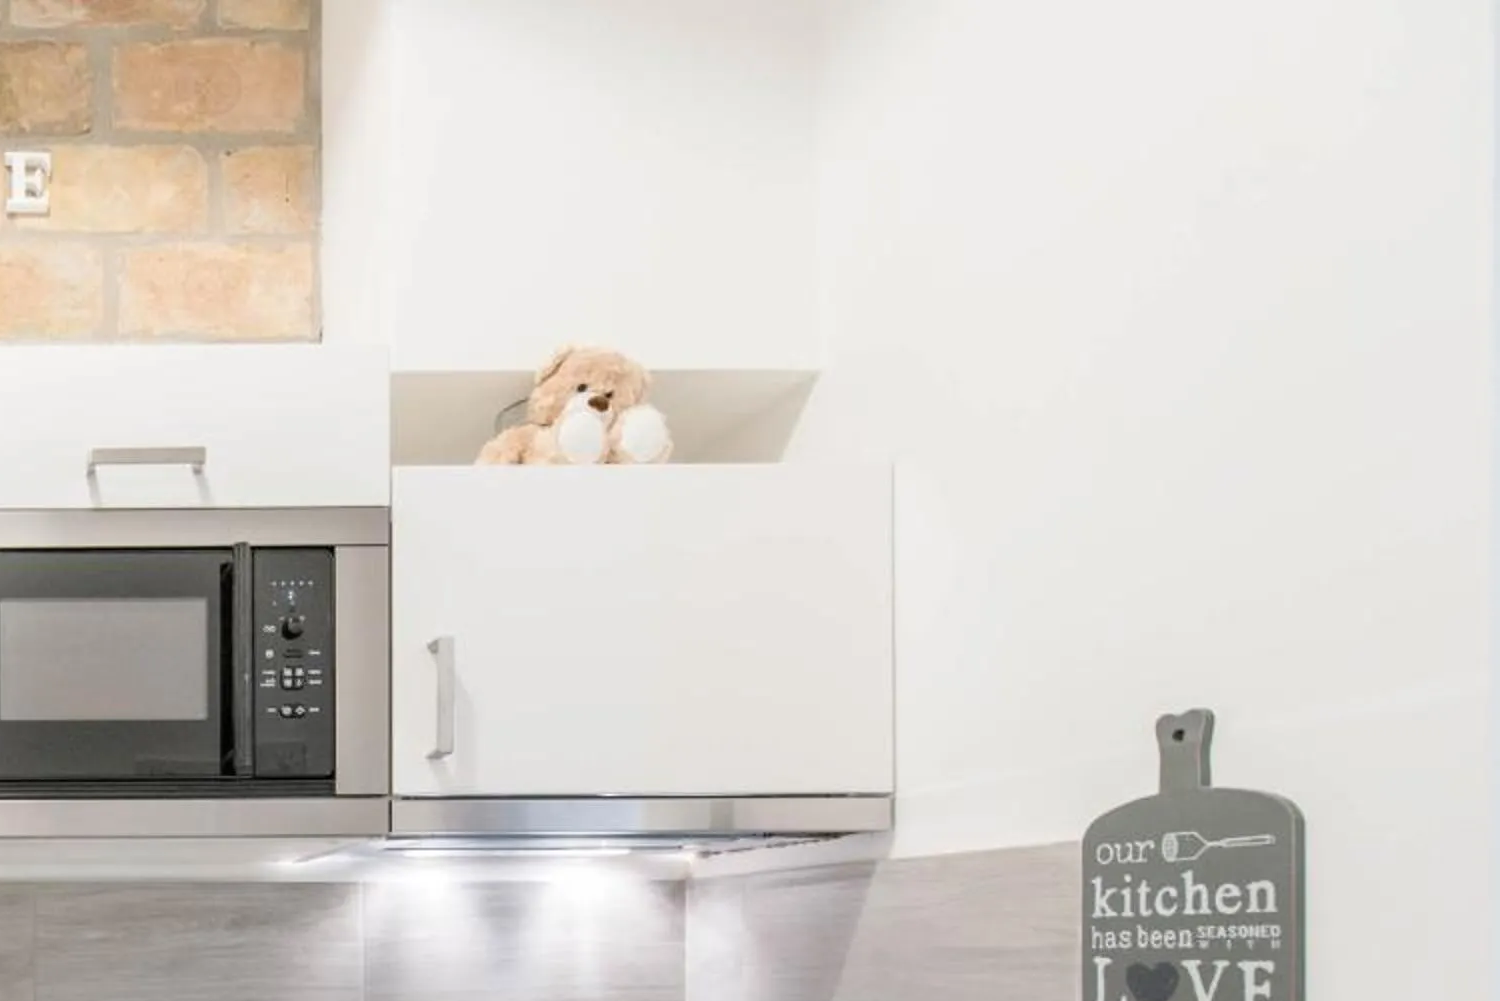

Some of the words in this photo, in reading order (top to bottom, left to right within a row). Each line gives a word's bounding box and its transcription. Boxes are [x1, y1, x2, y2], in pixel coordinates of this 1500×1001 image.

[1096, 839, 1155, 865] our
[1091, 870, 1278, 918] kitchen
[1091, 926, 1132, 949] has
[1137, 925, 1193, 949] been
[1196, 924, 1281, 939] SEASONED
